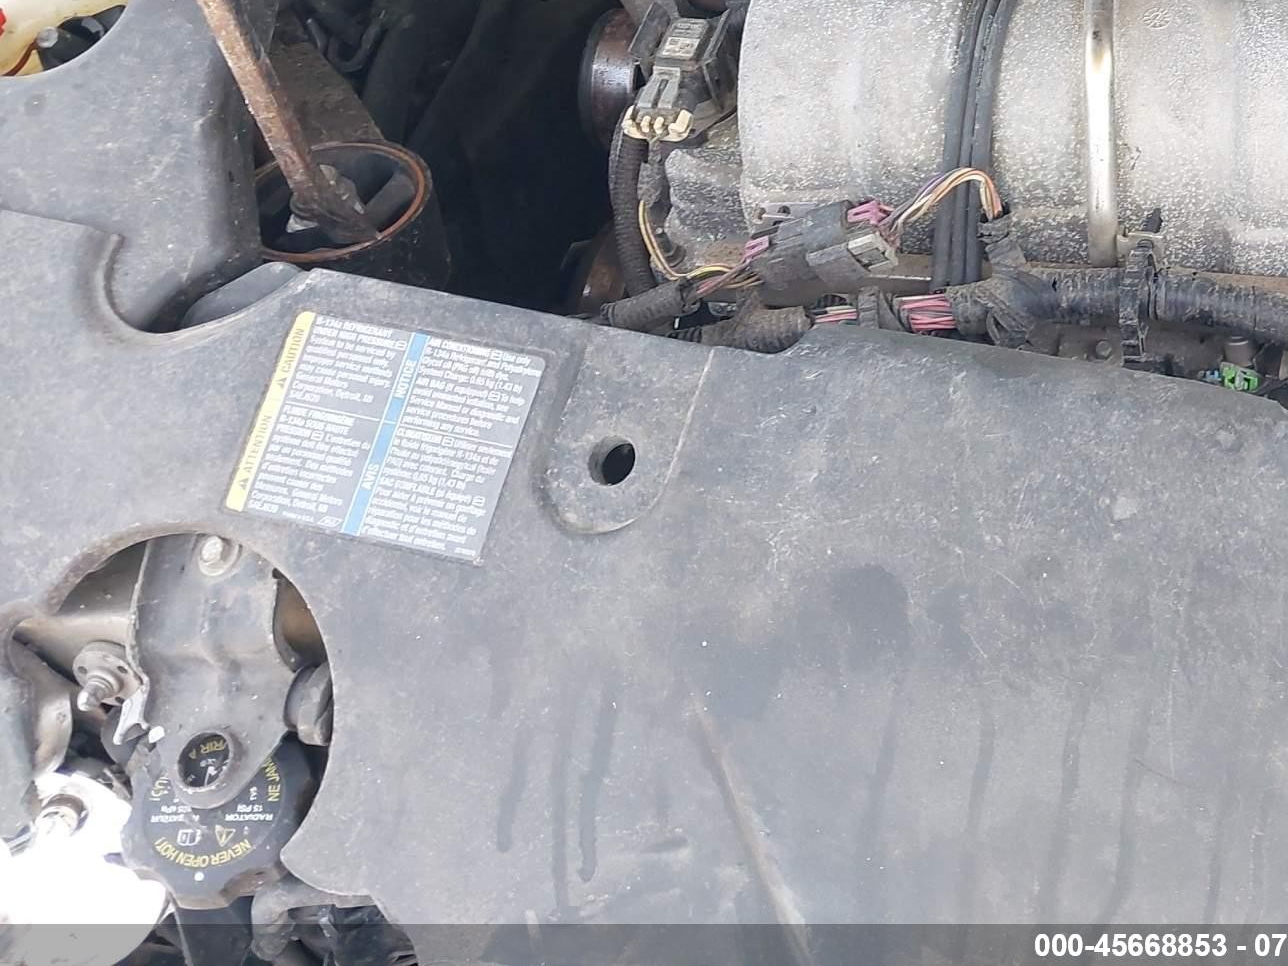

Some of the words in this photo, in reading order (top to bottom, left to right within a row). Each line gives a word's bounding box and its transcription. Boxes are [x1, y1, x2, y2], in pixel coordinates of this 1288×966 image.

[279, 326, 305, 375] CAUTION
[394, 359, 418, 398] NOTICE
[246, 413, 273, 479] ATTENTION
[361, 463, 380, 490] AVIS
[225, 813, 273, 822] RADIATOR
[175, 850, 210, 868] OPEN
[211, 838, 253, 865] NEVER
